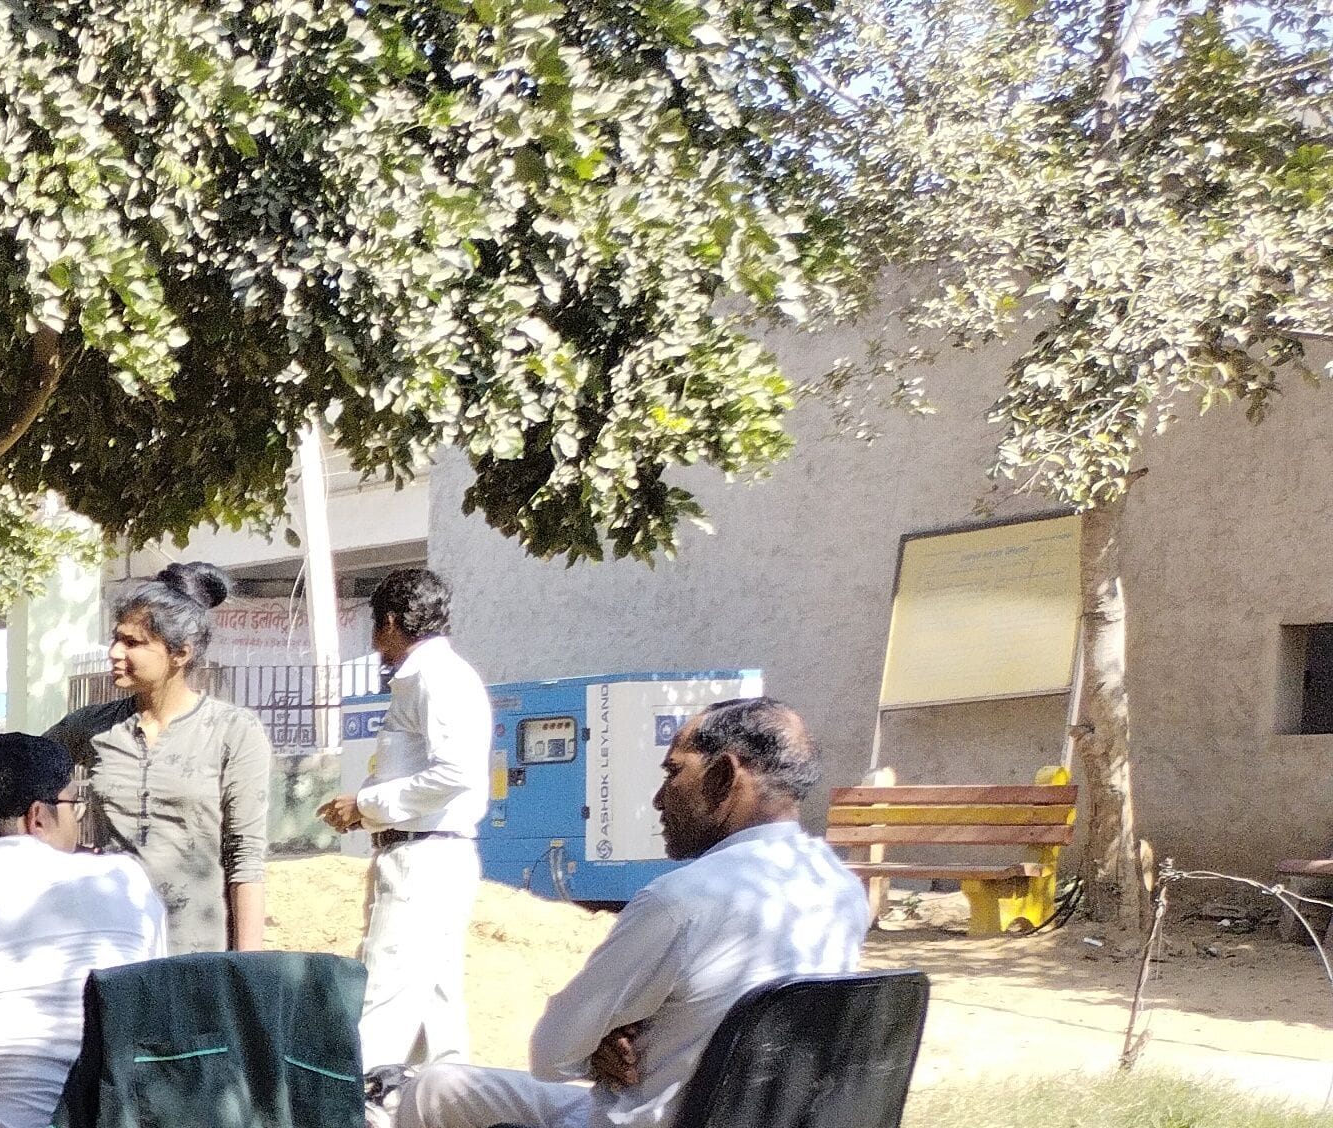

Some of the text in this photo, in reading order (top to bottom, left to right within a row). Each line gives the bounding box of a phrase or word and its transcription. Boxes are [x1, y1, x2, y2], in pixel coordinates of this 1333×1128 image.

[215, 609, 246, 629] यादव
[600, 684, 609, 836] ASHOK LEYLAND
